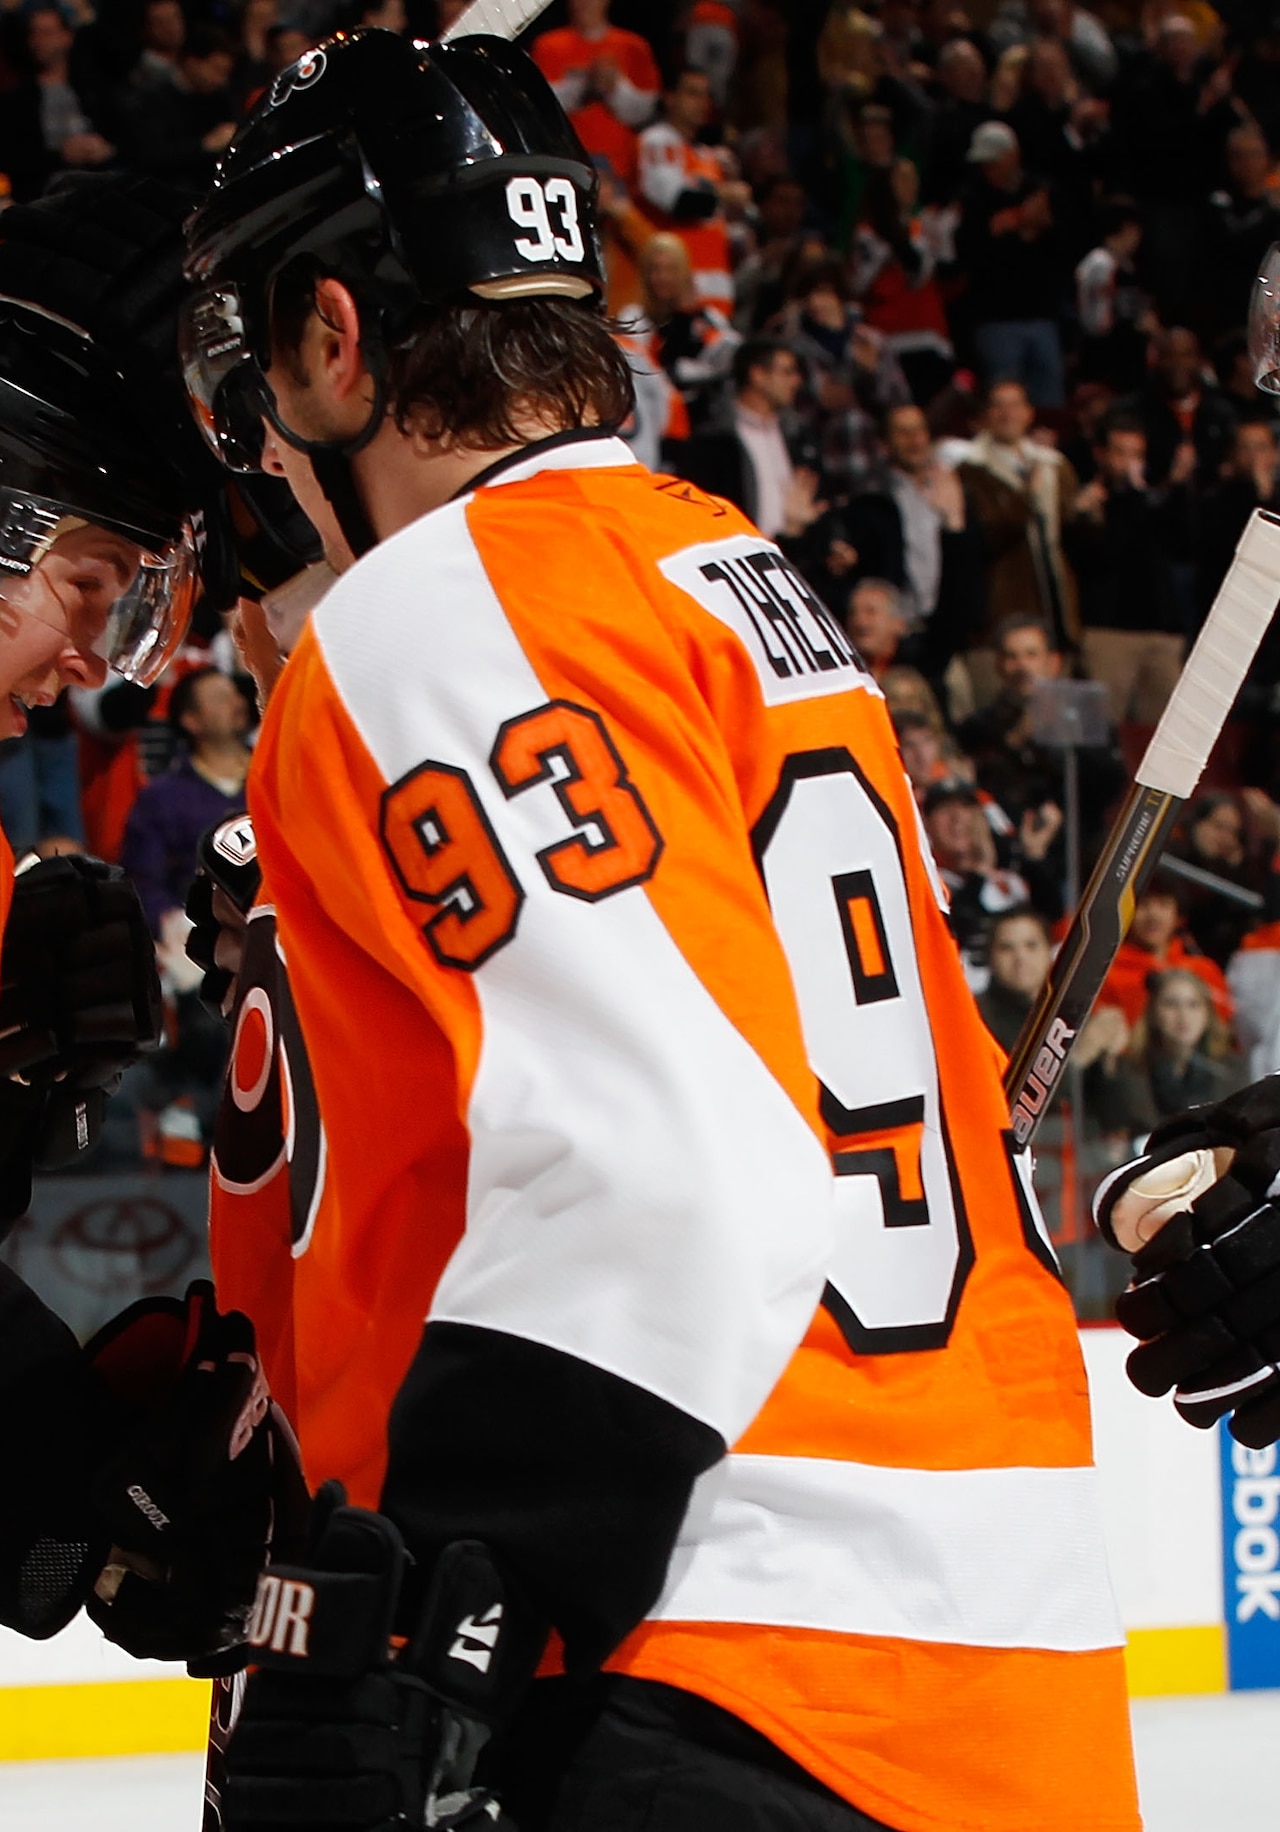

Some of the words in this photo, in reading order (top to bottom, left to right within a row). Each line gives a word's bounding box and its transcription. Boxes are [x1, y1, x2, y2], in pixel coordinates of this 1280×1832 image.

[505, 177, 585, 262] 93
[378, 698, 665, 972] 93
[126, 1484, 171, 1531] GIROUX
